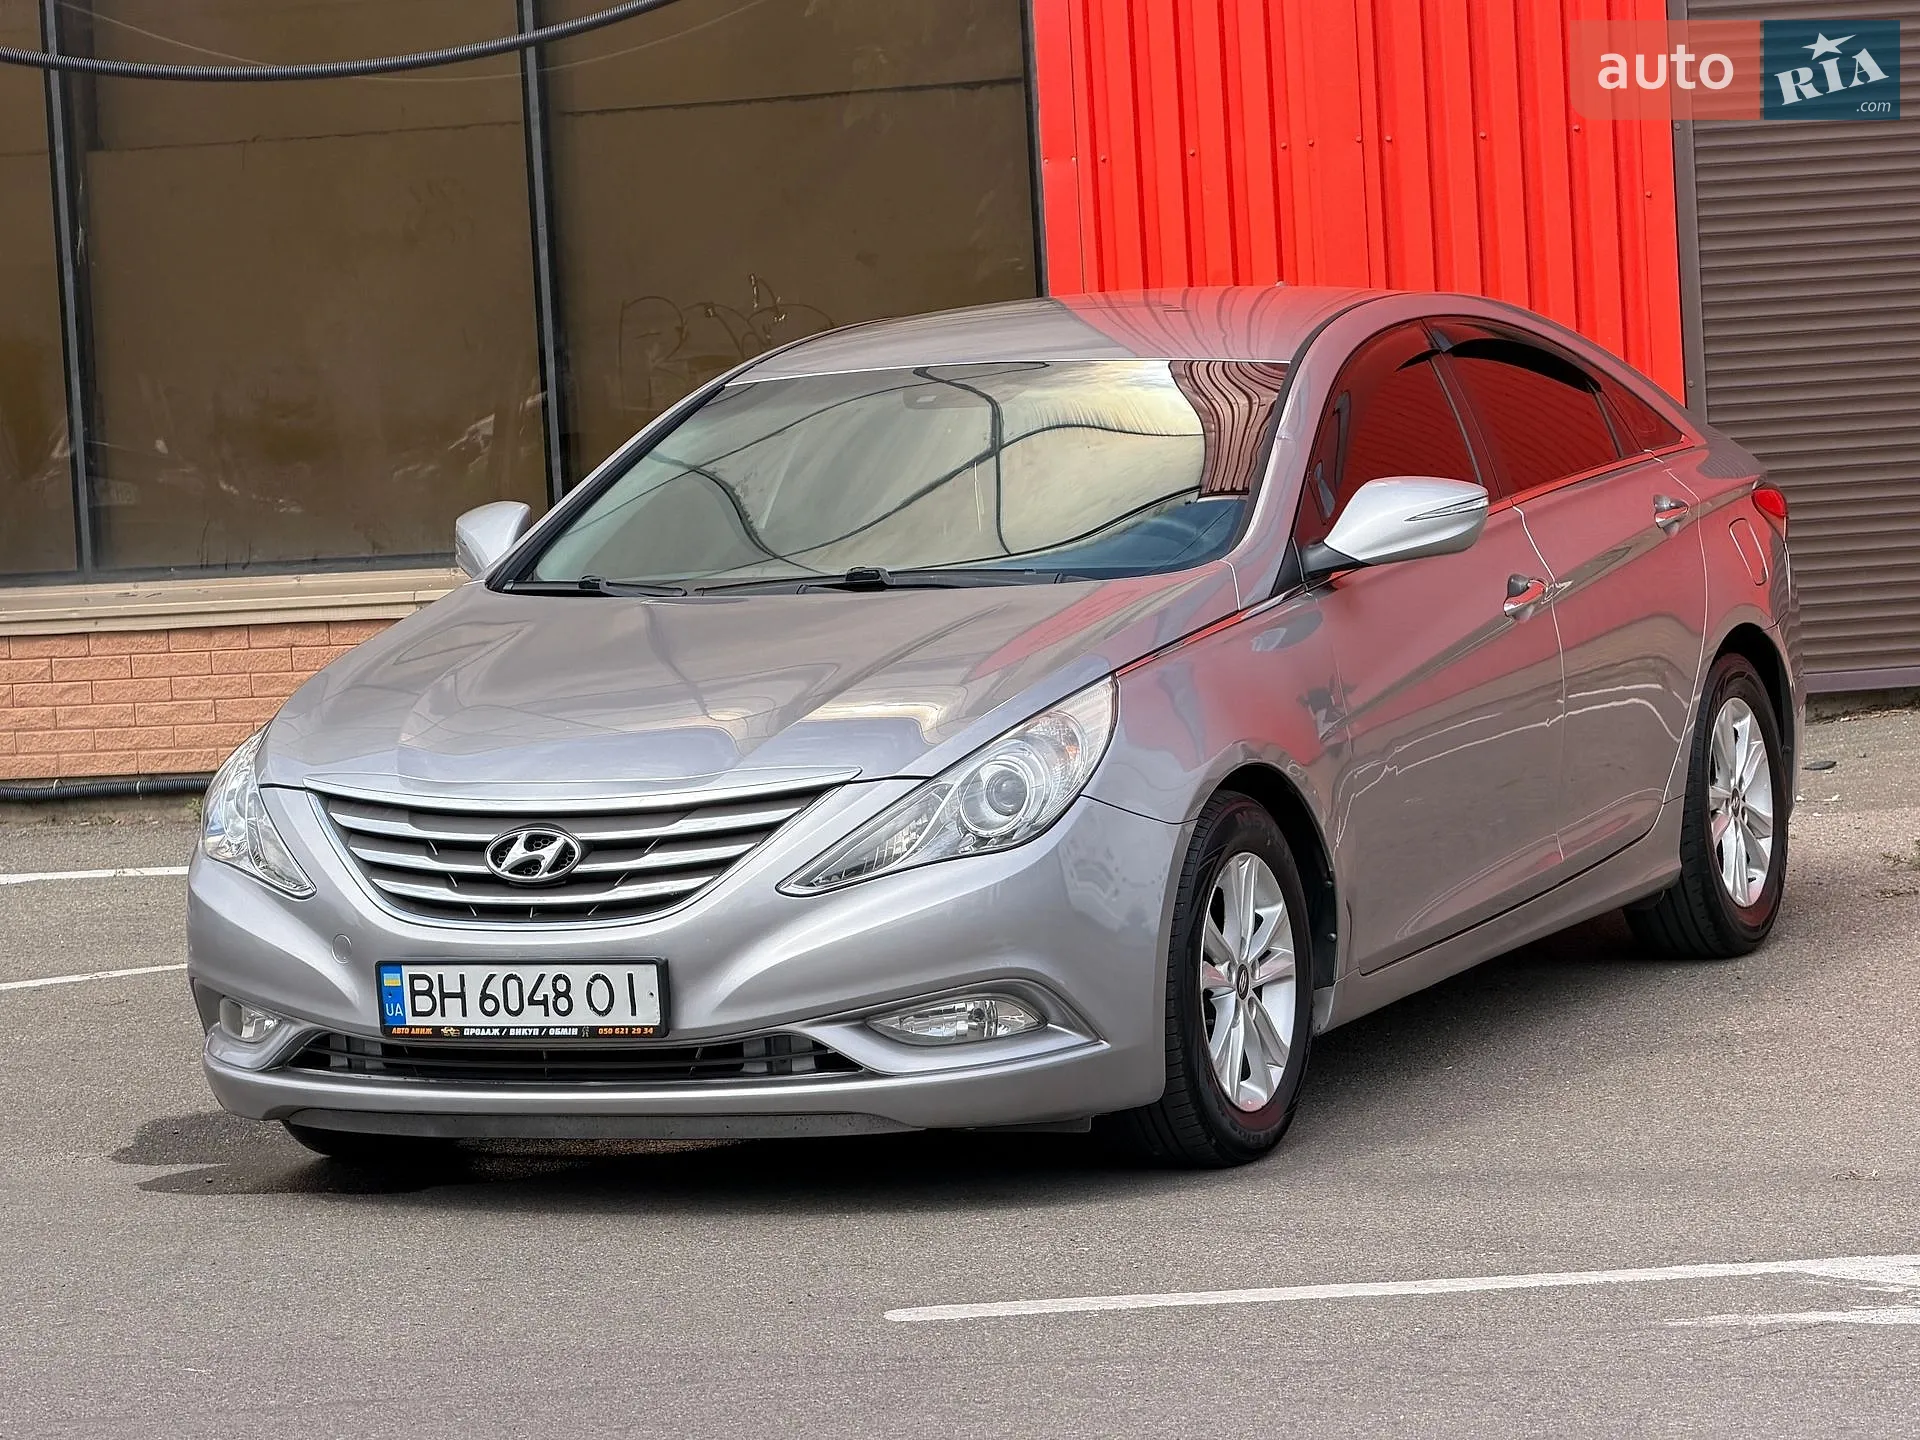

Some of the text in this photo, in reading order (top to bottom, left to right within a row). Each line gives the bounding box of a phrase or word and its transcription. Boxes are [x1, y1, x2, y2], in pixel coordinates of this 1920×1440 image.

[408, 972, 467, 1017] BH
[479, 972, 574, 1017] 6048
[385, 1003, 404, 1017] UA
[463, 1027, 500, 1036] ПРОДАЖ
[509, 1027, 540, 1036] ВИКУП
[548, 1027, 579, 1036] ОБМІН
[598, 1027, 613, 1035] 050
[614, 1027, 629, 1035] 621
